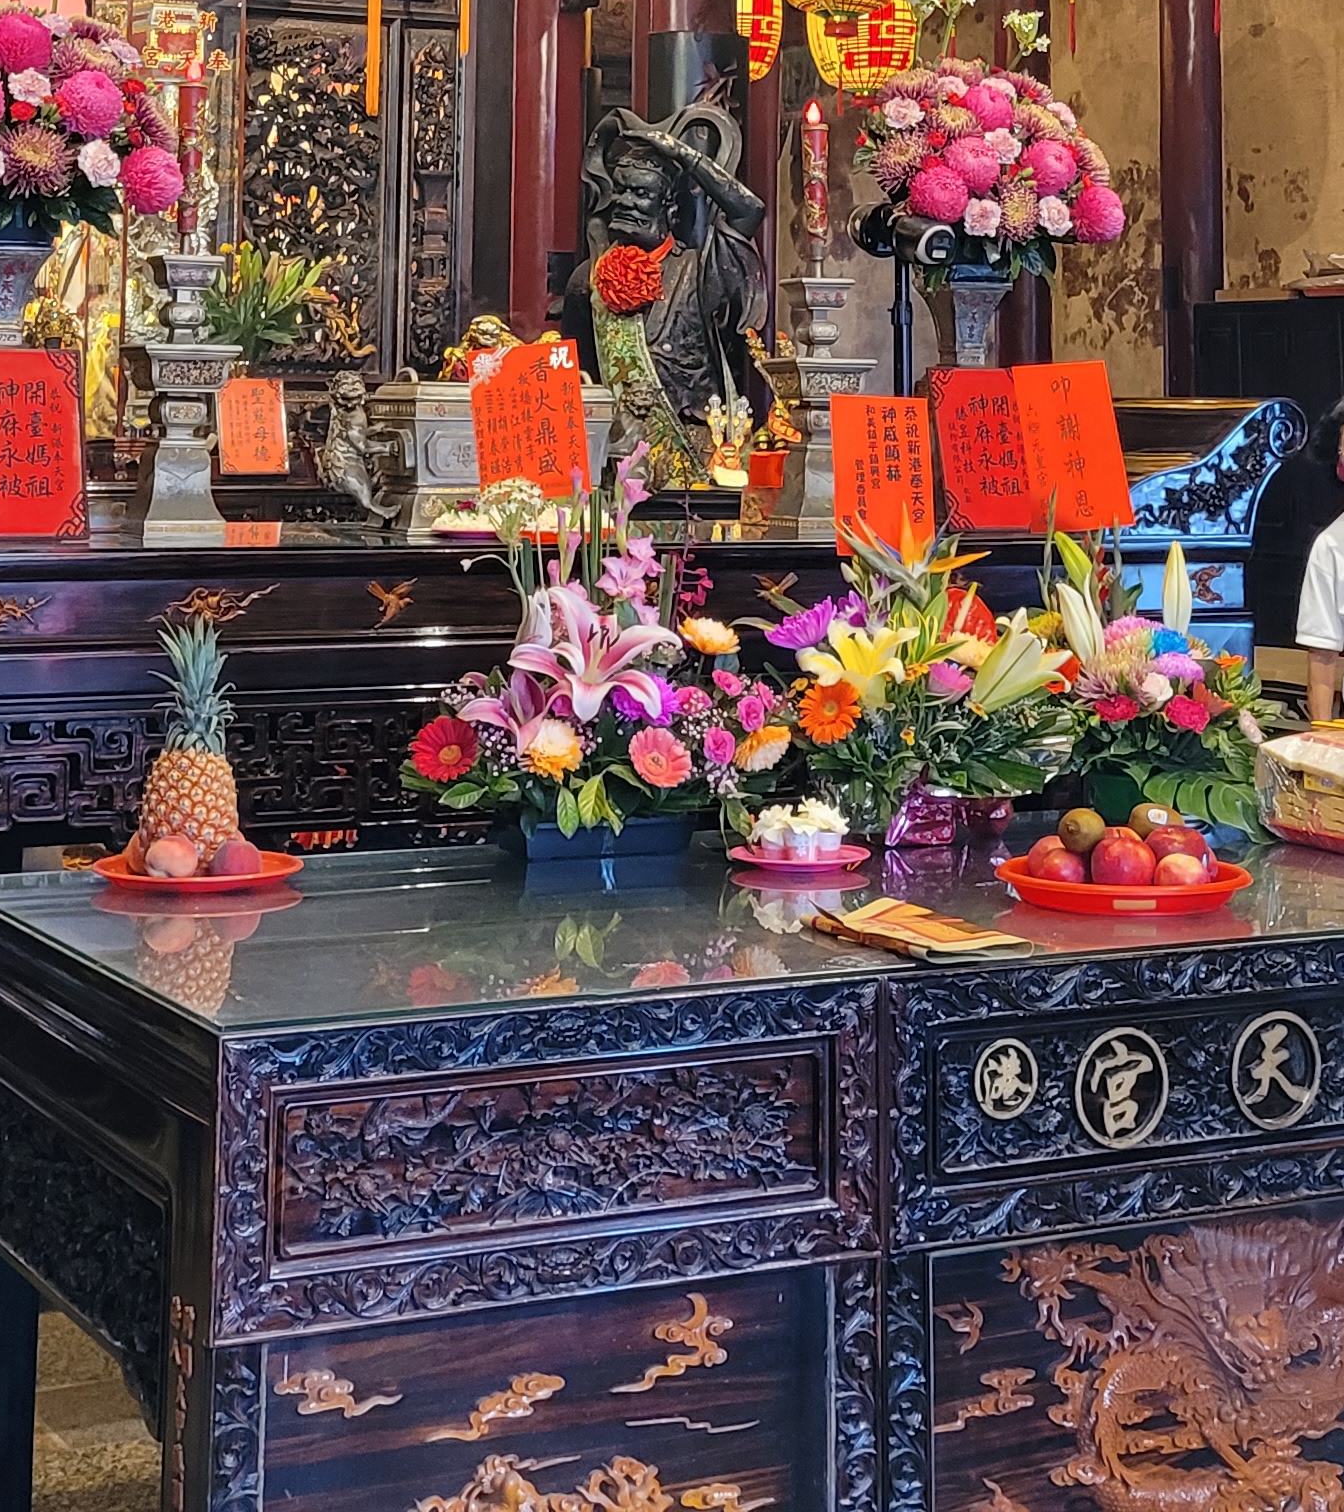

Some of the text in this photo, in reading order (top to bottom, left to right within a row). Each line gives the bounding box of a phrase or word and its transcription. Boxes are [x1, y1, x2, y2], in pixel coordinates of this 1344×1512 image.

[529, 356, 564, 477] 香火鼎盛
[549, 346, 574, 370] 祝
[22, 380, 55, 499] 開臺媽祖
[991, 395, 1024, 496] 開臺媽祖
[1050, 375, 1095, 519] 叩謝神恩
